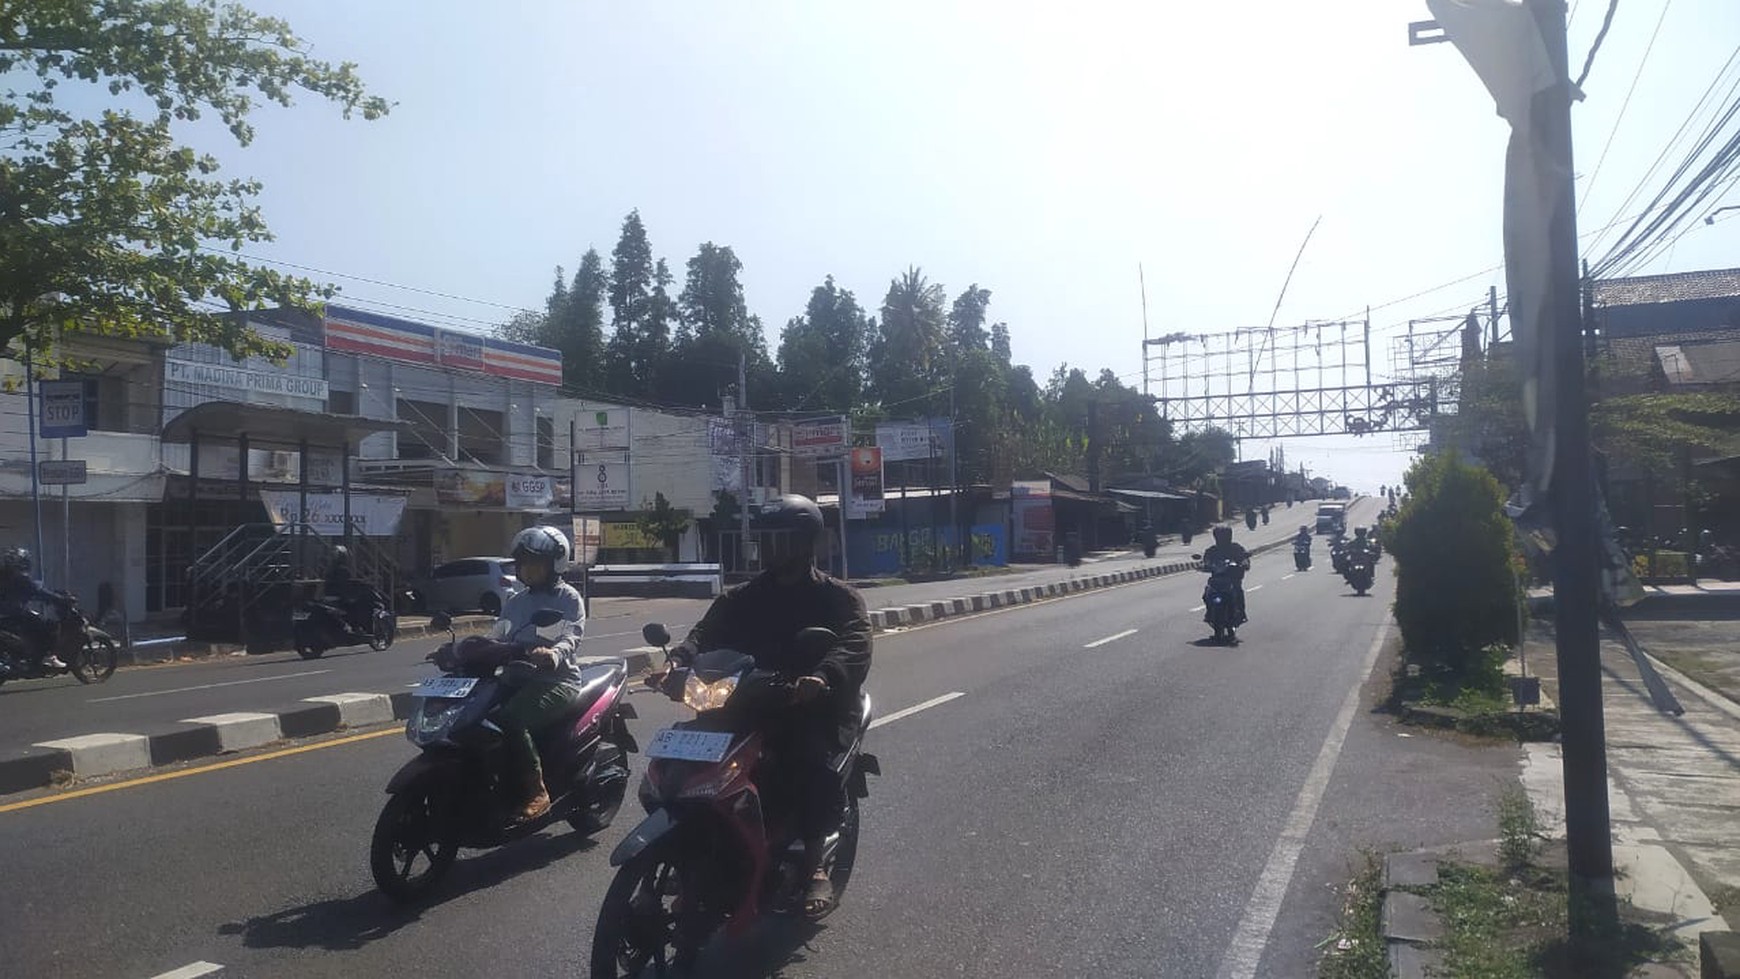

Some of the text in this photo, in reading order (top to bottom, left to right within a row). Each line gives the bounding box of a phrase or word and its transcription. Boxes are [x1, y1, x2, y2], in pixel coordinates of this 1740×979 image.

[171, 361, 324, 397] PT. MADINA PRIMA GROUP
[47, 404, 79, 421] STOP
